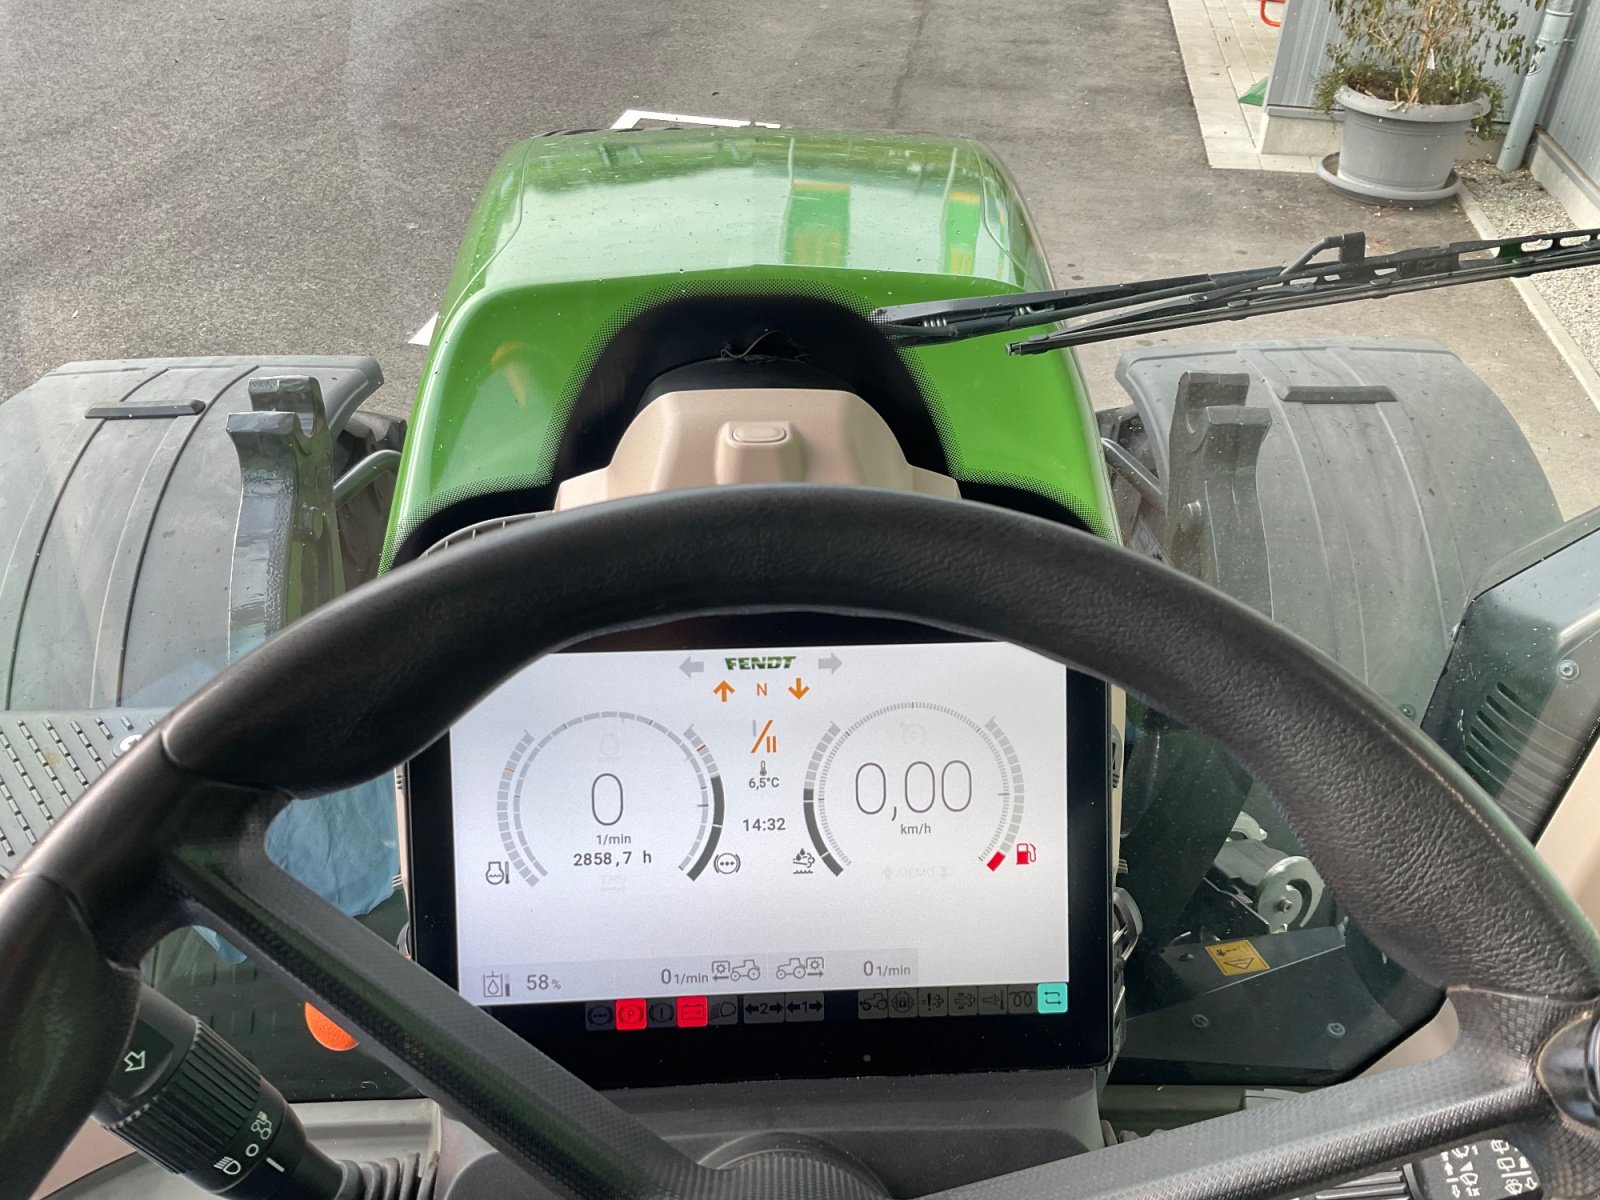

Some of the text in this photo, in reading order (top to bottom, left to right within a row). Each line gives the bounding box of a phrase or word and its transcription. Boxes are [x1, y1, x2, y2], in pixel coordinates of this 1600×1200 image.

[724, 655, 797, 671] FENDT
[756, 682, 768, 696] N
[748, 776, 780, 790] 6,5°C
[855, 759, 972, 822] 0,00
[591, 772, 624, 826] 0
[743, 817, 787, 832] 14:32
[900, 823, 932, 836] km/h
[596, 832, 632, 846] 1/min
[572, 850, 652, 868] 2858,7 h
[660, 967, 709, 985] 0 1/min
[863, 960, 911, 977] 0 1/min
[526, 973, 550, 991] 58
[759, 1003, 769, 1015] 2
[801, 1002, 809, 1014] 1
